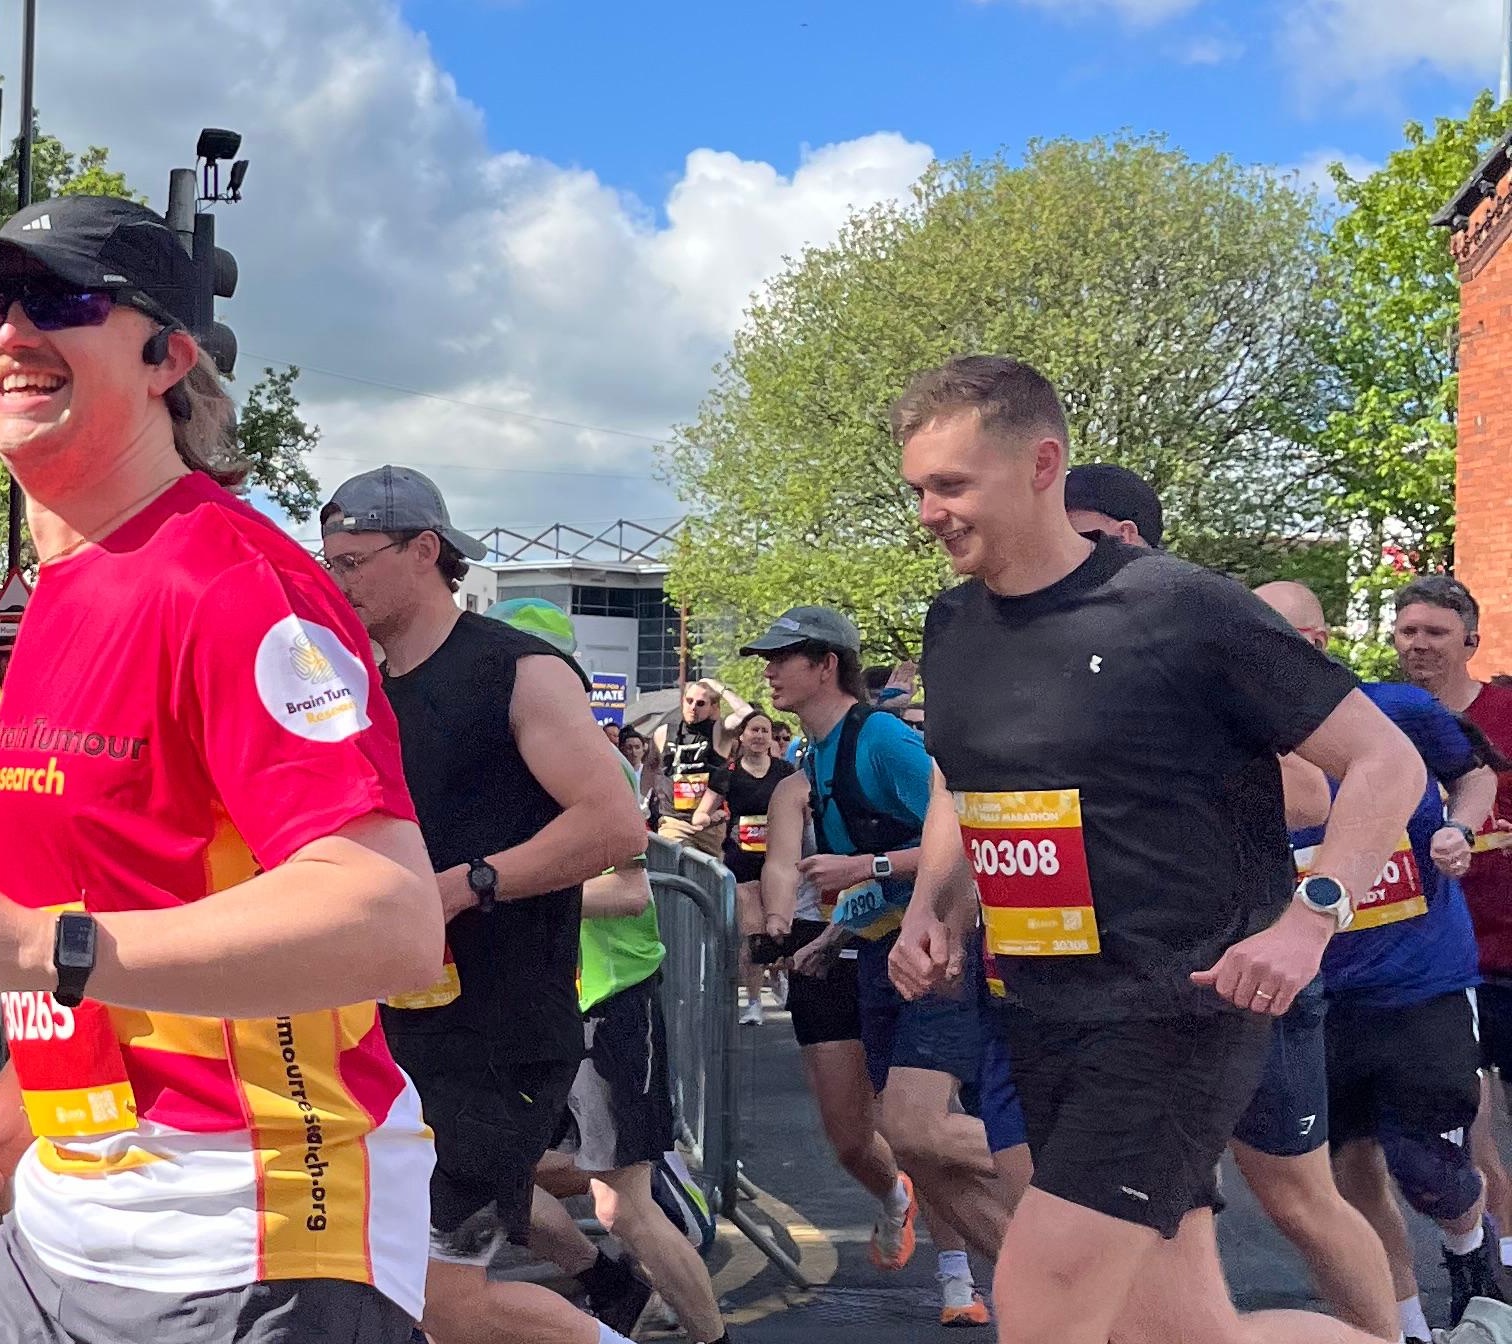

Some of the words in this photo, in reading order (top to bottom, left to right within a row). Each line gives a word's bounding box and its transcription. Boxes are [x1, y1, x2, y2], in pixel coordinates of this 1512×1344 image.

[285, 693, 326, 714] Brain
[591, 690, 625, 702] MATE
[30, 717, 150, 761] Tumour
[970, 838, 1060, 876] 30308
